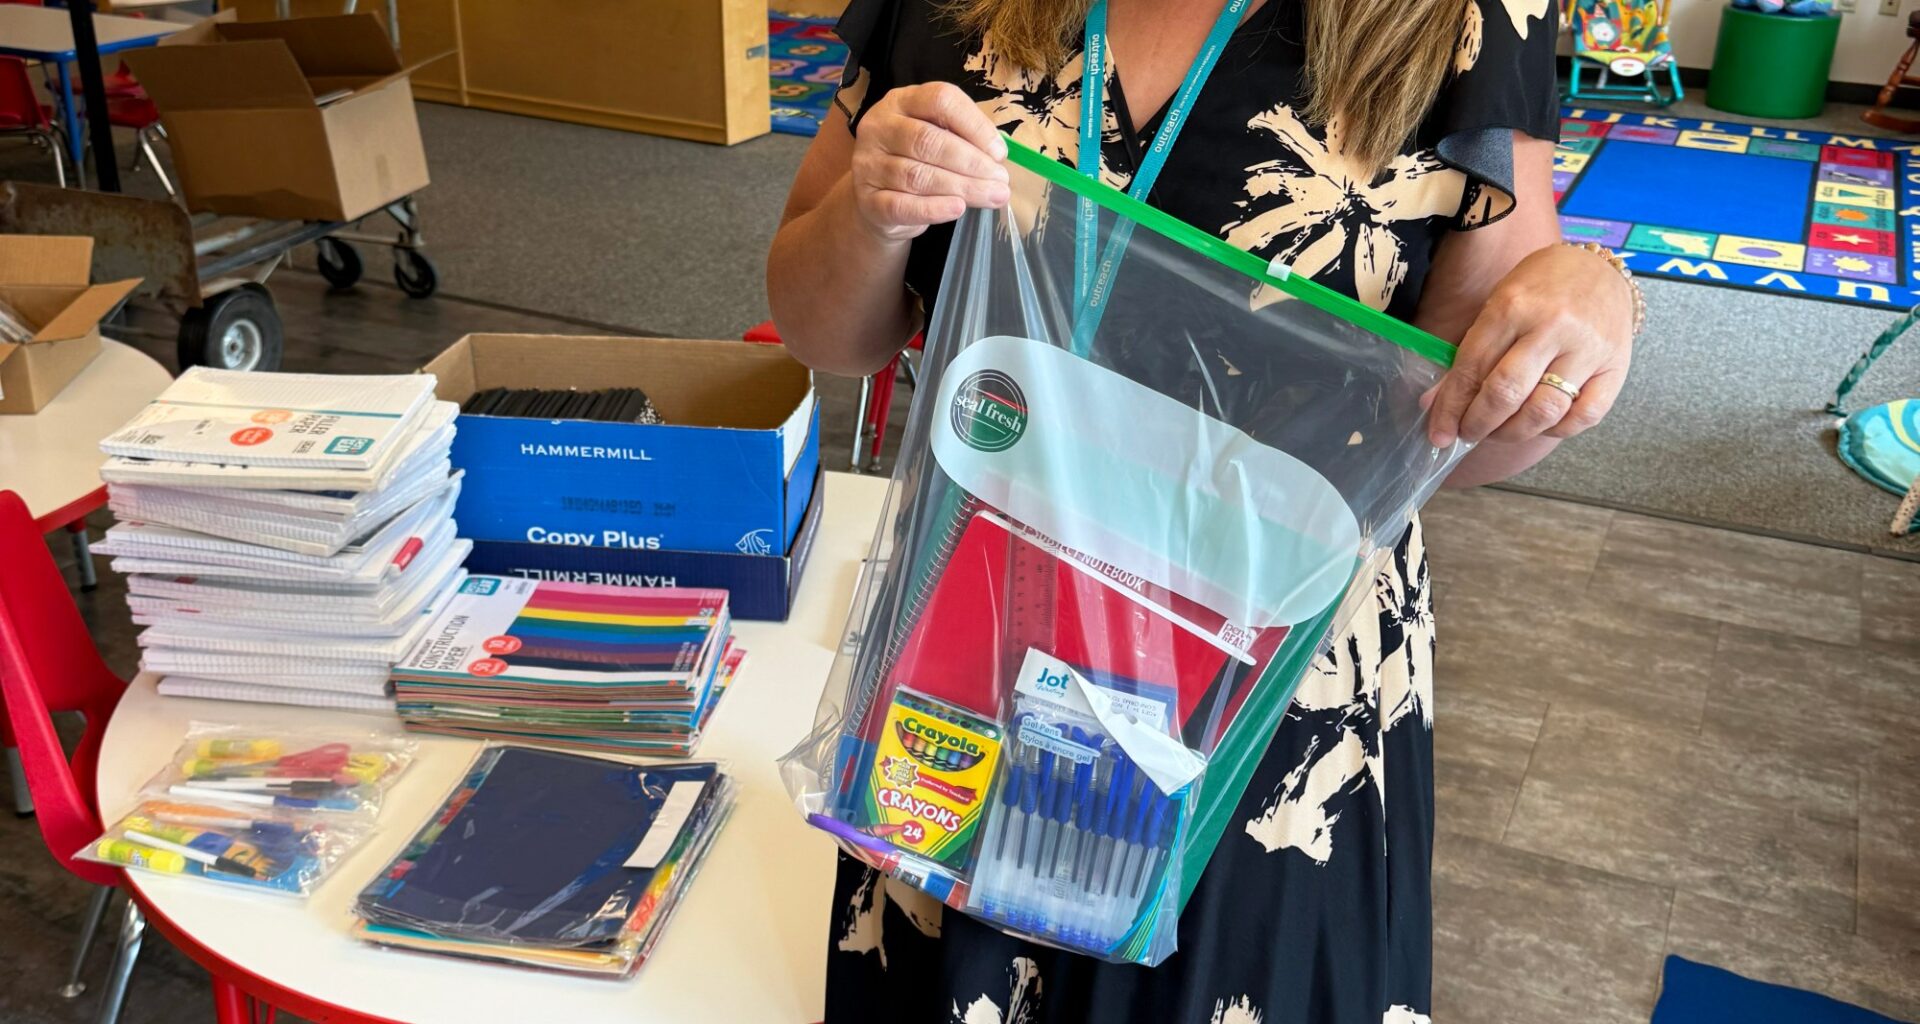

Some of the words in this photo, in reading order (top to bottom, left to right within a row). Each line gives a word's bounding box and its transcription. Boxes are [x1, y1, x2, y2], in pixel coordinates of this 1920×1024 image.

[1090, 33, 1100, 77] outreach
[1154, 108, 1181, 153] outreach
[1642, 116, 1680, 128] K
[1698, 122, 1725, 132] L
[1827, 136, 1877, 149] M
[1090, 259, 1113, 308] outreach
[289, 413, 320, 434] PAPER
[308, 415, 341, 436] FILLER
[955, 394, 984, 414] seal
[985, 403, 1022, 434] fresh
[521, 443, 654, 461] HAMMERMILL
[603, 529, 661, 550] Plus
[1082, 554, 1145, 591] NOTEBOOK
[419, 615, 470, 669] CONSTRUCTION
[438, 647, 468, 670] PAPER
[1037, 668, 1069, 689] Jot
[903, 717, 981, 755] Crayola
[1023, 718, 1038, 729] Gel
[1039, 722, 1059, 736] Pens
[1020, 732, 1044, 747] Stylos
[1044, 740, 1051, 750] à
[1052, 744, 1074, 757] encre
[1076, 751, 1091, 764] gel
[877, 789, 961, 832] CRAYONS
[903, 825, 922, 840] 24
